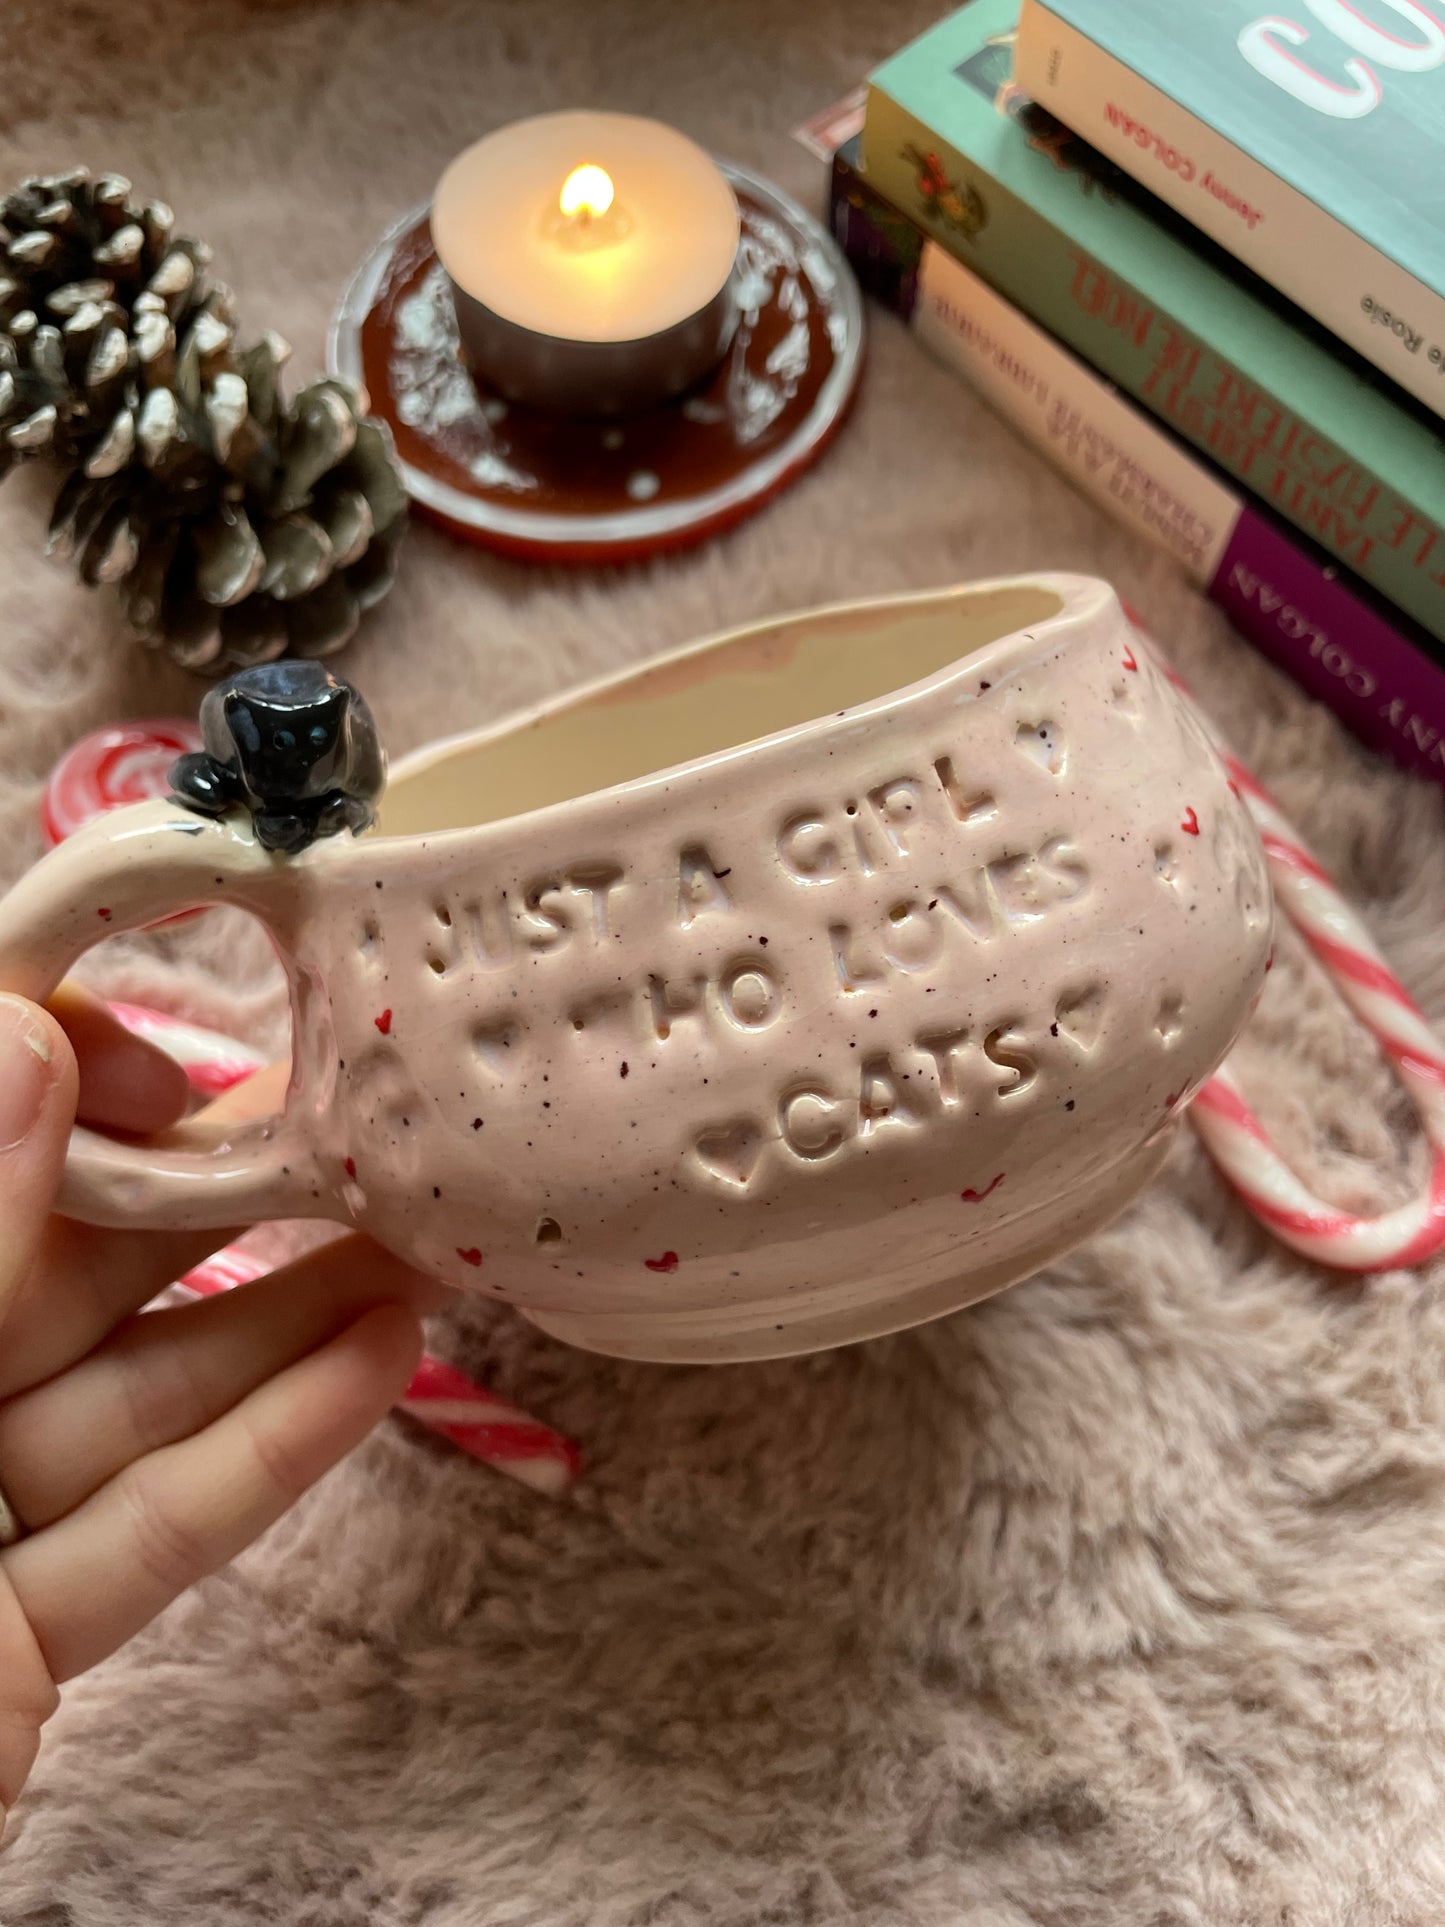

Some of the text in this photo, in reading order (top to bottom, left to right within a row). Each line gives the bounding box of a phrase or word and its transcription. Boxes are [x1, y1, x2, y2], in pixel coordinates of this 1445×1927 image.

[1103, 102, 1264, 230] Jenny COLGAN
[1360, 294, 1424, 355] Rosie
[1228, 560, 1377, 699] COLGAN
[425, 857, 626, 980] JUST
[677, 840, 732, 931] A
[828, 834, 1092, 998] LOVES
[778, 1020, 1041, 1164] CATS
